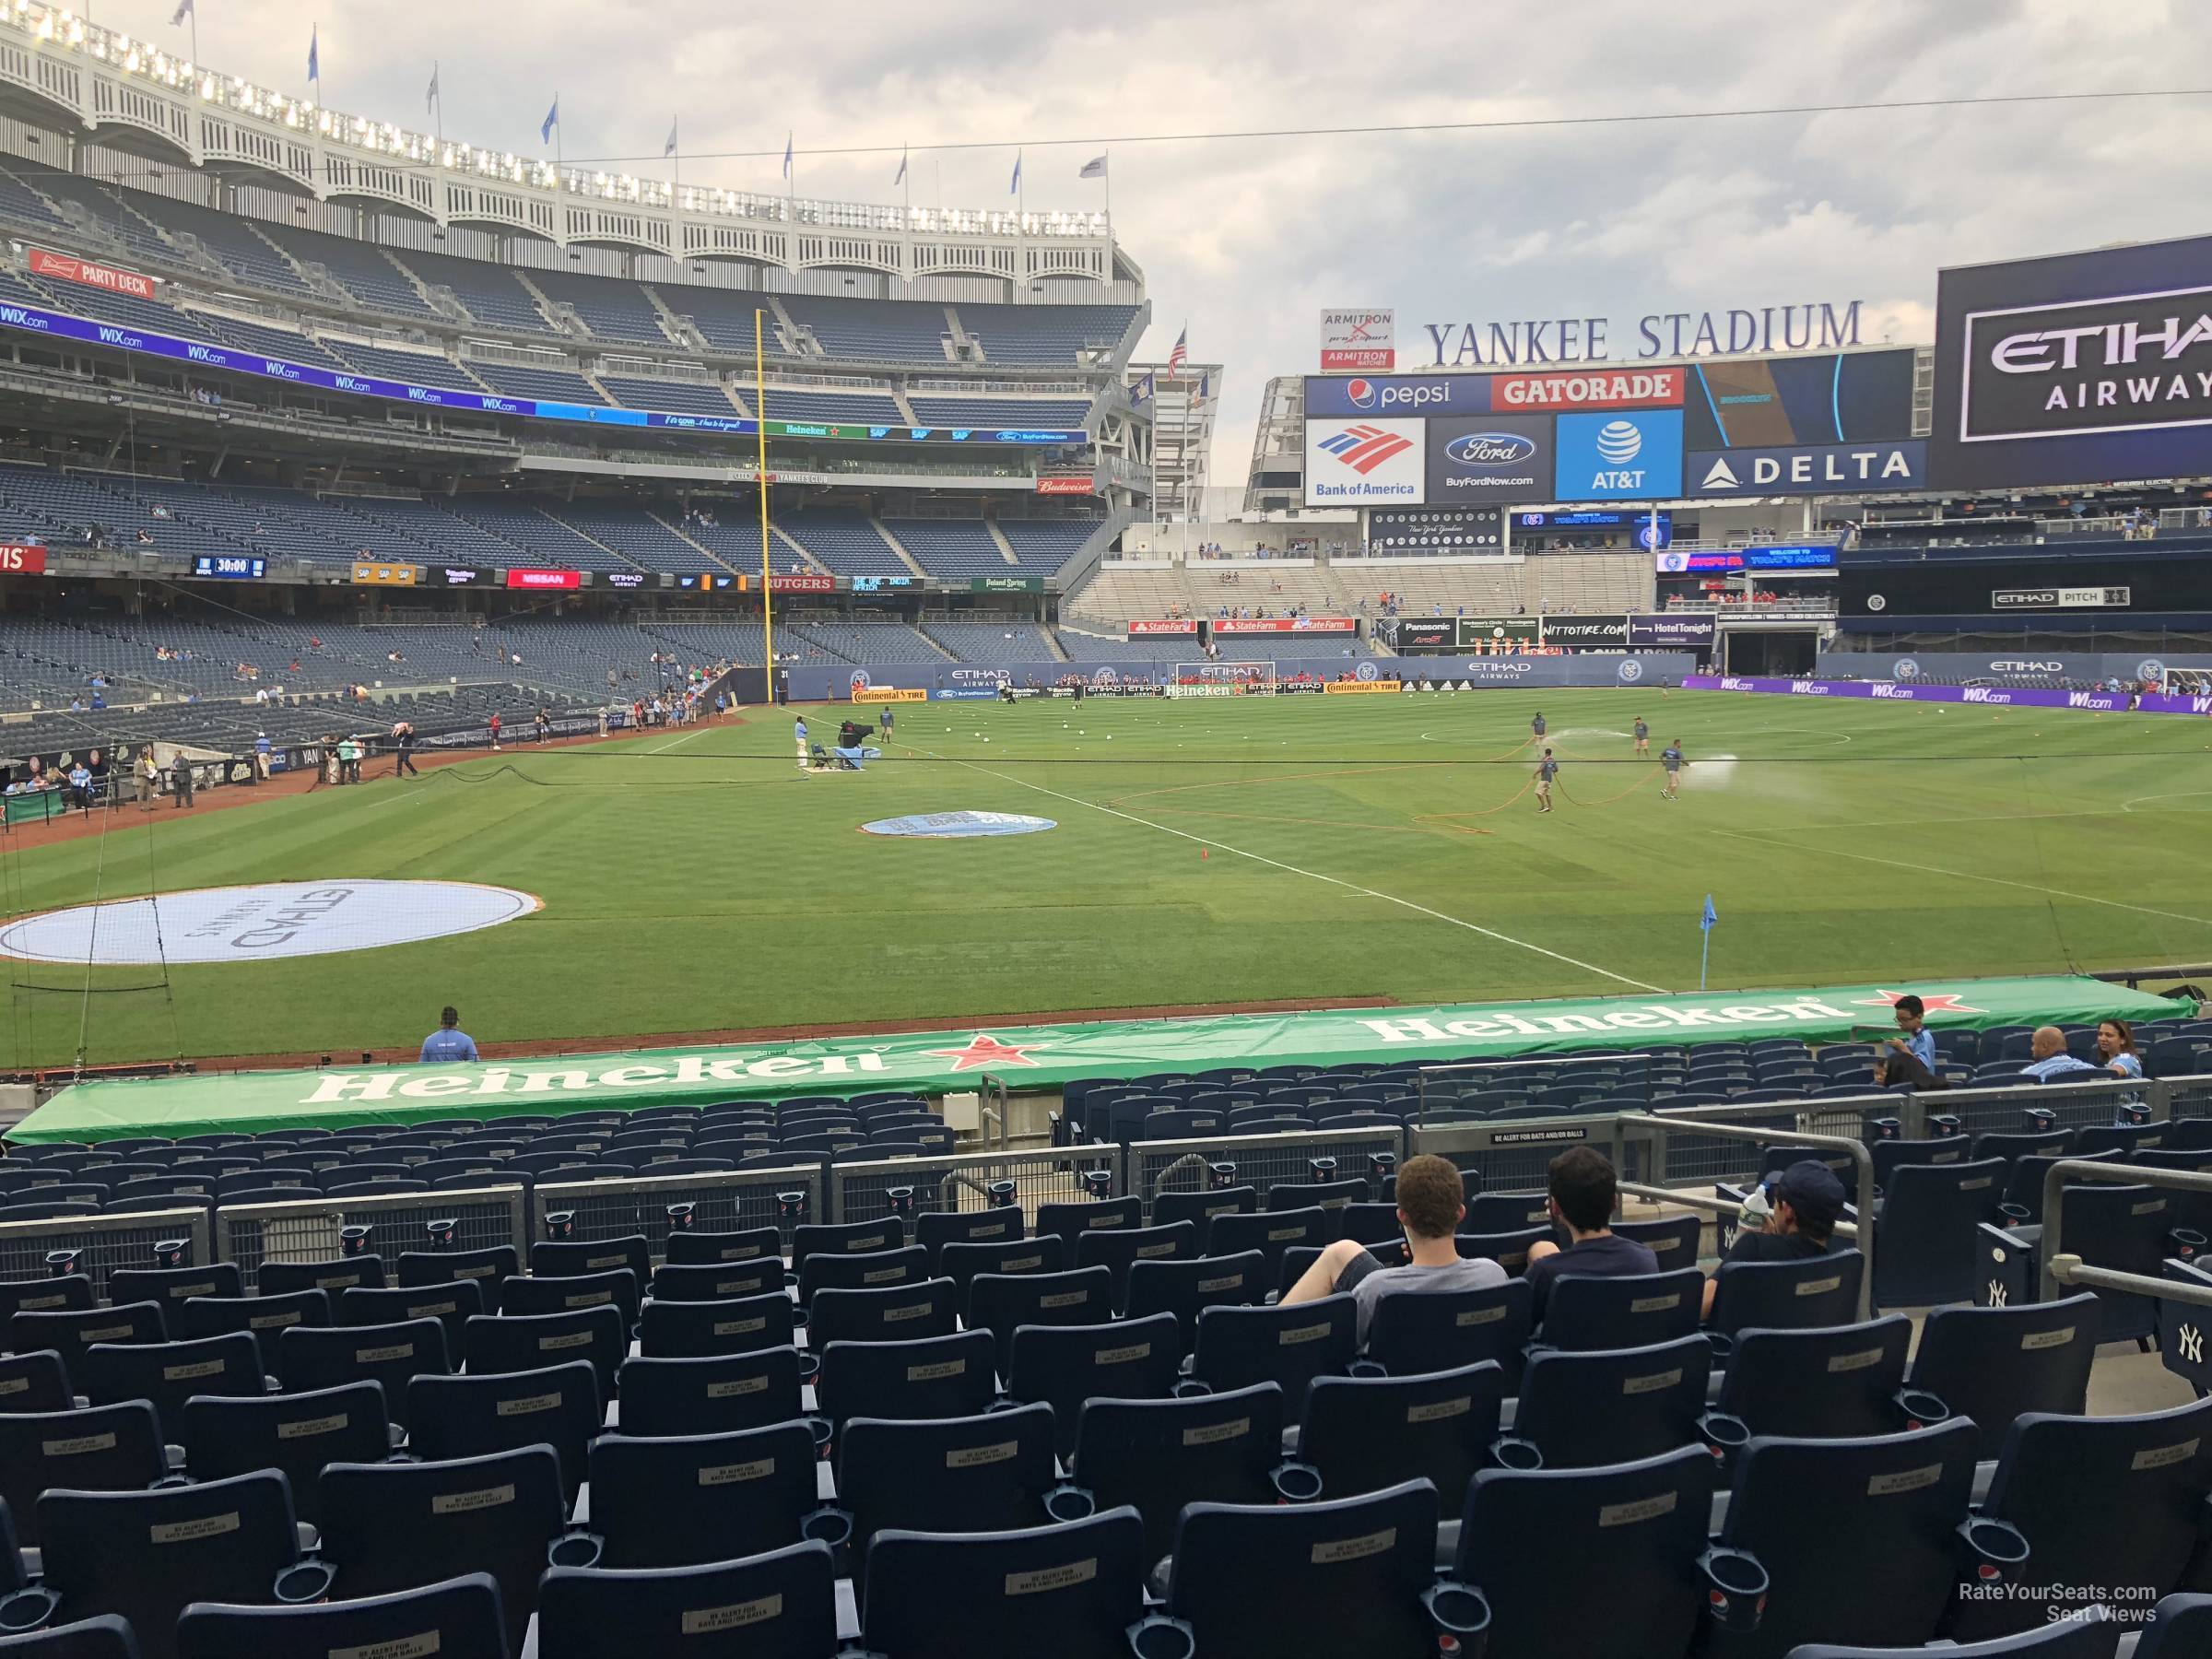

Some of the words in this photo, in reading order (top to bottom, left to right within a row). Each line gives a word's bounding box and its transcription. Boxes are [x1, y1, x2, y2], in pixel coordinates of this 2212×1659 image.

[82, 265, 116, 287] PARTY
[119, 275, 147, 295] DECK
[1324, 314, 1392, 324] ARMITRON
[1423, 317, 1608, 367] YANKEE
[1638, 300, 1865, 359] STADIUM
[1328, 351, 1388, 361] ARMITRON
[1381, 381, 1450, 408] pepsi
[1503, 374, 1671, 405] GATORADE
[785, 424, 827, 436] Heineken
[869, 428, 886, 438] SAP
[912, 429, 927, 439] SAP
[951, 429, 968, 440] SAP
[1462, 438, 1516, 461] Ford
[1754, 451, 1911, 484] DELTA
[779, 474, 809, 483] YANKEES
[811, 475, 828, 483] CLUB
[1446, 477, 1534, 488] BuyFordNow.com
[1592, 470, 1645, 489] AT&T
[1039, 479, 1093, 492] Budweiser
[1316, 483, 1347, 496] Bank
[1348, 483, 1361, 495] of
[1362, 482, 1415, 495] America
[1408, 524, 1422, 533] New
[1422, 524, 1437, 535] York
[1438, 524, 1464, 535] Yankees
[218, 559, 247, 572] 30:00
[358, 569, 371, 579] SAP
[378, 570, 391, 579] SAP
[398, 570, 411, 580] SAP
[523, 573, 565, 584] NISSAN
[765, 577, 830, 590] RUTGERS
[986, 578, 1006, 587] Poland
[1007, 578, 1027, 588] Spring
[1996, 594, 2054, 603] ETIHAD
[2065, 593, 2098, 602] PITCH
[1405, 622, 1451, 631] Panasonic
[1542, 623, 1628, 637] NITTOTIRE.COM
[1654, 622, 1712, 633] HotelTonight
[1200, 665, 1261, 677] ETIHAD
[1468, 663, 1532, 672] ETIHAD
[1990, 661, 2064, 672] ETIHAD
[951, 669, 1010, 679] ETIHAD
[1166, 684, 1230, 697] Heineken
[1288, 683, 1322, 691] ETIHAD
[1326, 683, 1372, 694] Continental
[854, 691, 900, 701] Continental
[299, 1051, 891, 1104] Heineken
[1502, 1134, 1520, 1142] ALERT
[1531, 1132, 1545, 1140] BATS
[1546, 1131, 1566, 1139] AND/OR
[1566, 1130, 1584, 1138] BALLS
[1041, 1571, 1060, 1580] ALERT
[1062, 1568, 1074, 1576] FOR
[710, 1612, 718, 1620] BE
[721, 1608, 741, 1618] ALERT
[743, 1606, 757, 1614] FOR
[371, 1646, 393, 1655] ALERT
[395, 1642, 410, 1652] FOR
[399, 1643, 423, 1656] BALLS
